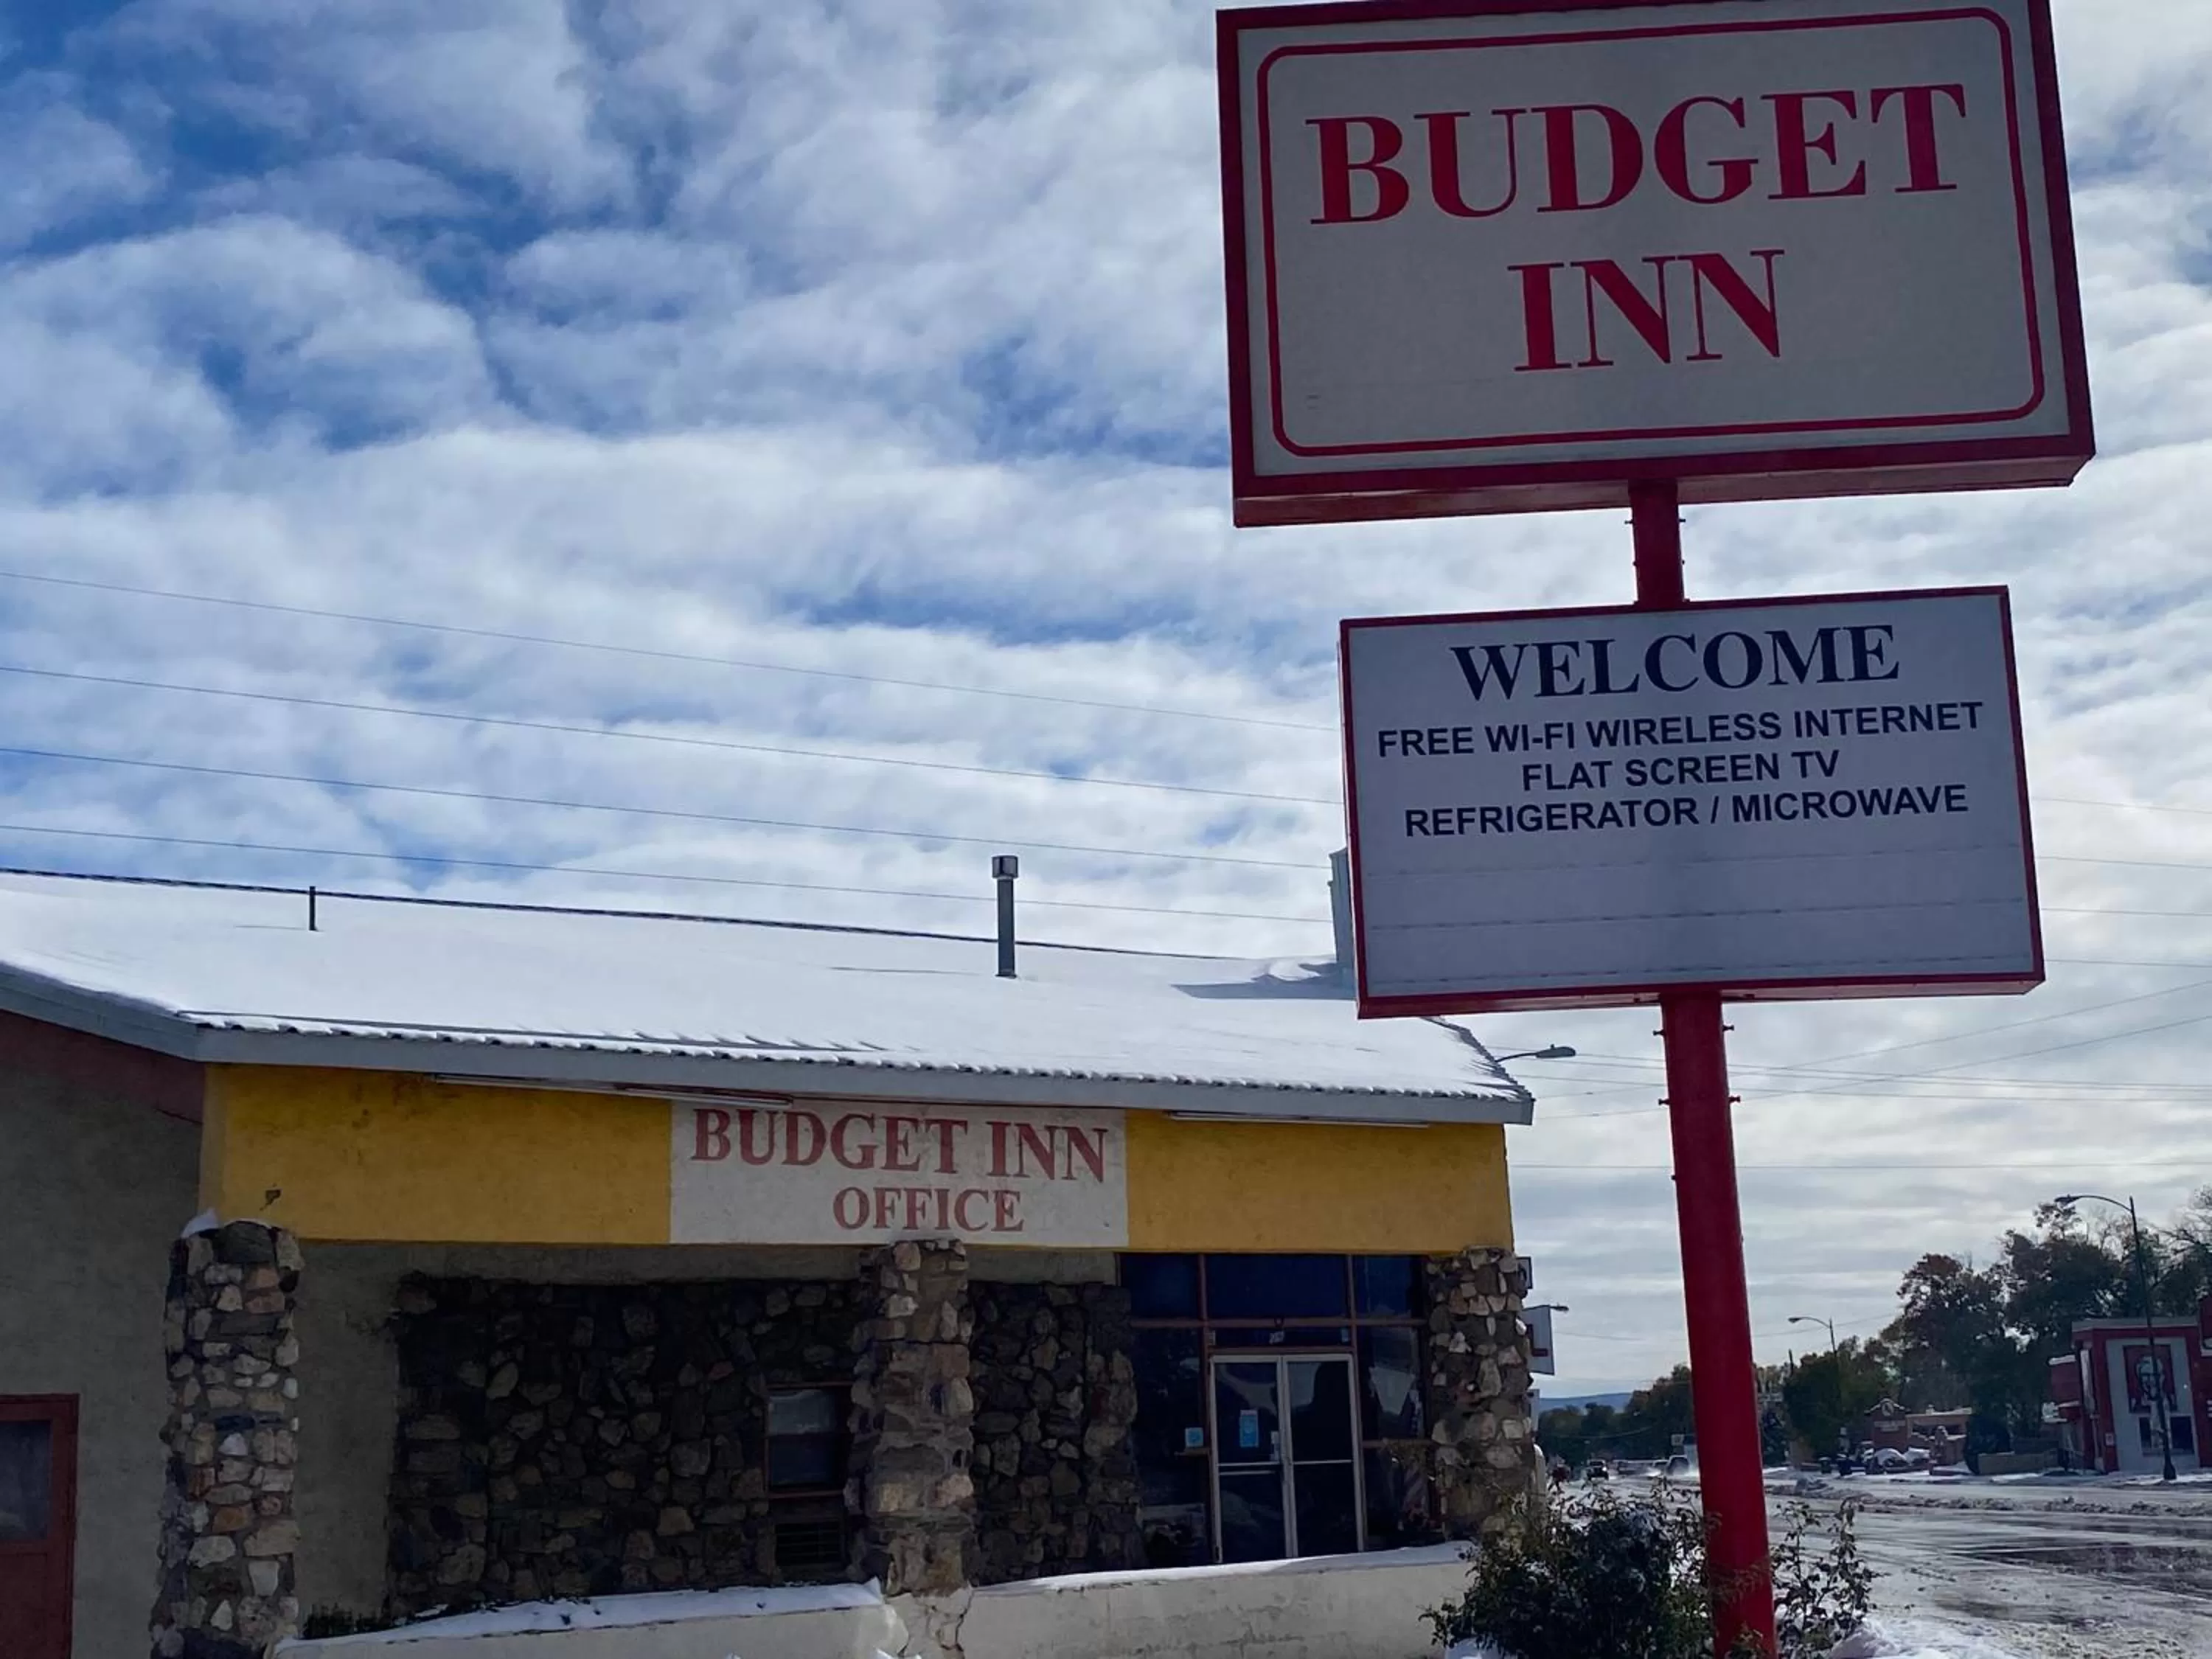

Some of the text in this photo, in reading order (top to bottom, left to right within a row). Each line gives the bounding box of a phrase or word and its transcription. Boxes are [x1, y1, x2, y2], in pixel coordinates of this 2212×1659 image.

[1305, 83, 1967, 224] BUDGET
[1507, 248, 1784, 372] INN
[1449, 624, 1899, 701] WELCOME
[1378, 701, 1983, 757] FREE WI-FI WIRELESS INTERNET
[1523, 749, 1840, 790] FLAT SCREEN TV
[1405, 784, 1969, 837] REFRIGERATOR / MICROWAVE
[691, 1107, 1109, 1183] BUDGET INN
[832, 1186, 1025, 1232] OFFICE
